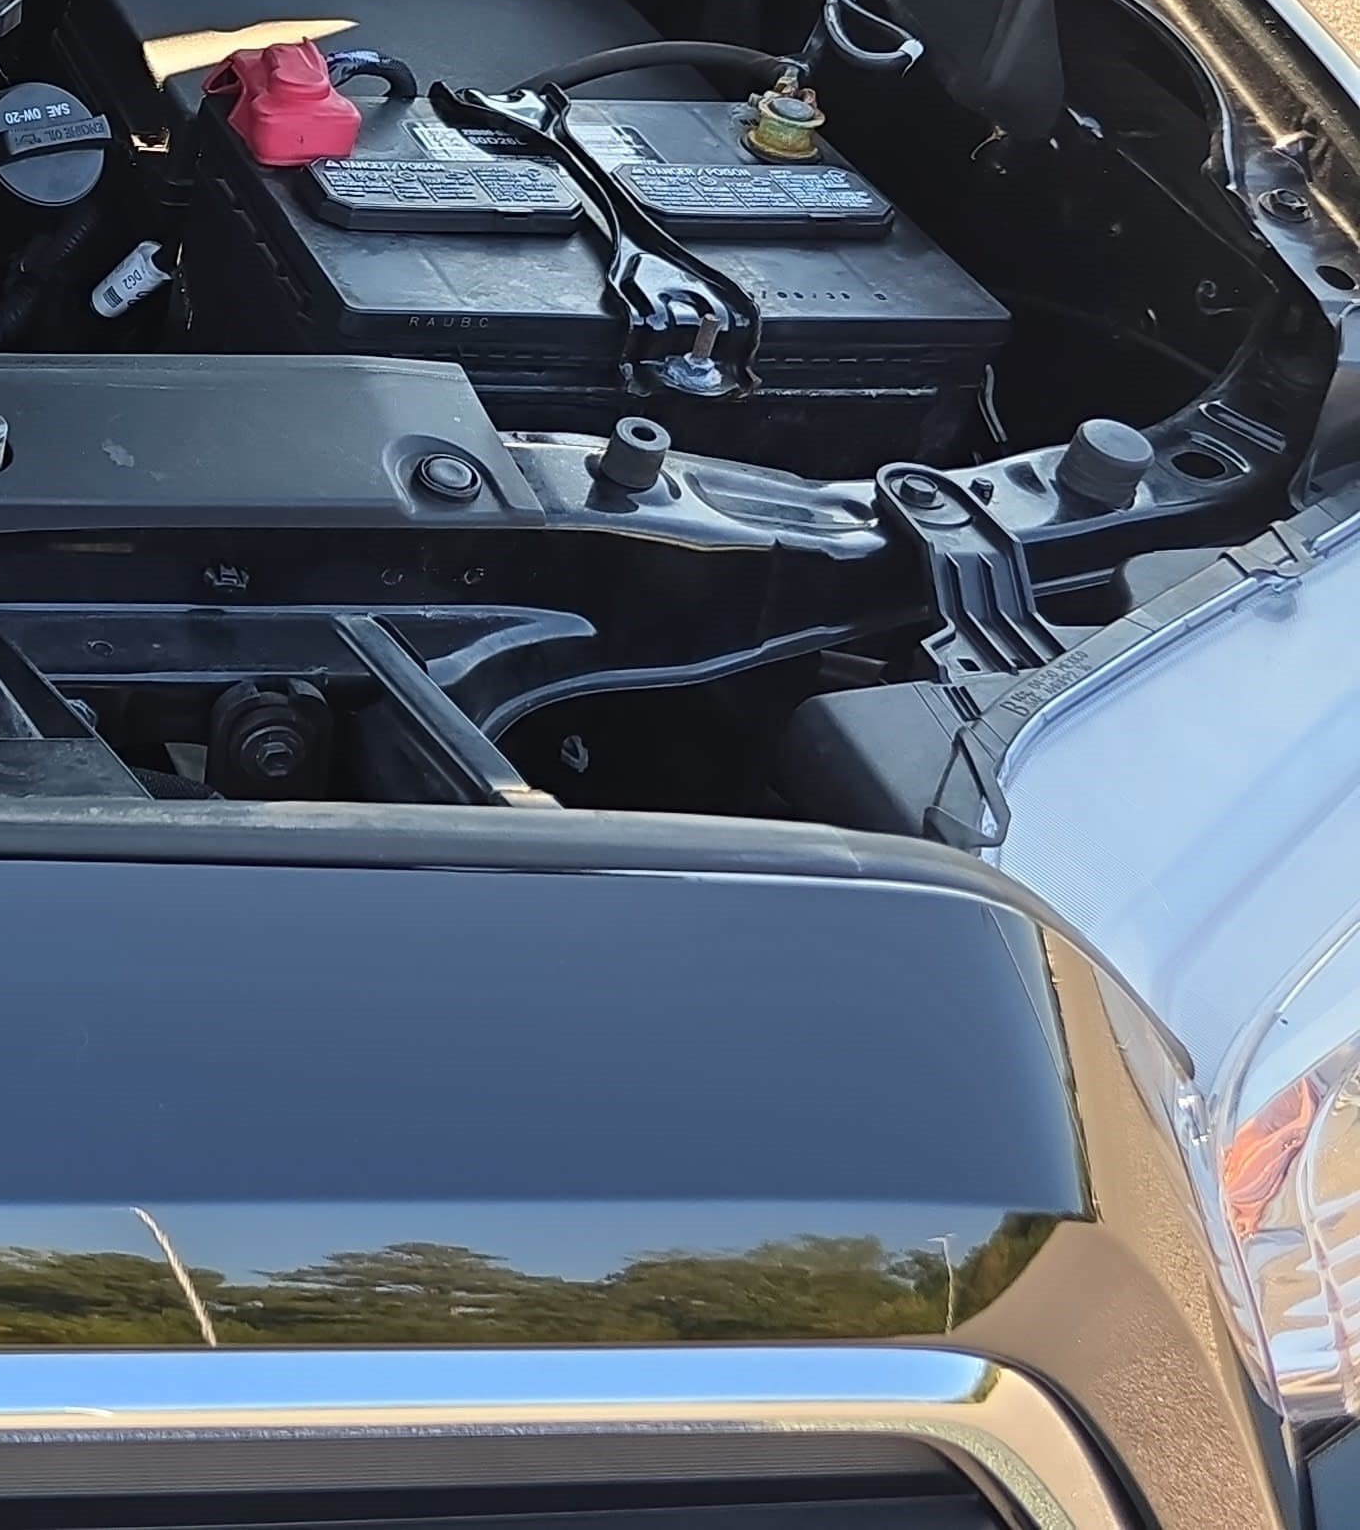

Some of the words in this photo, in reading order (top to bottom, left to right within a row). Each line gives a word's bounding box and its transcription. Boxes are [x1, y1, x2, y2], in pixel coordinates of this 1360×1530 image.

[4, 107, 42, 125] 0W-20
[45, 102, 71, 118] SAE
[44, 130, 63, 142] OIL
